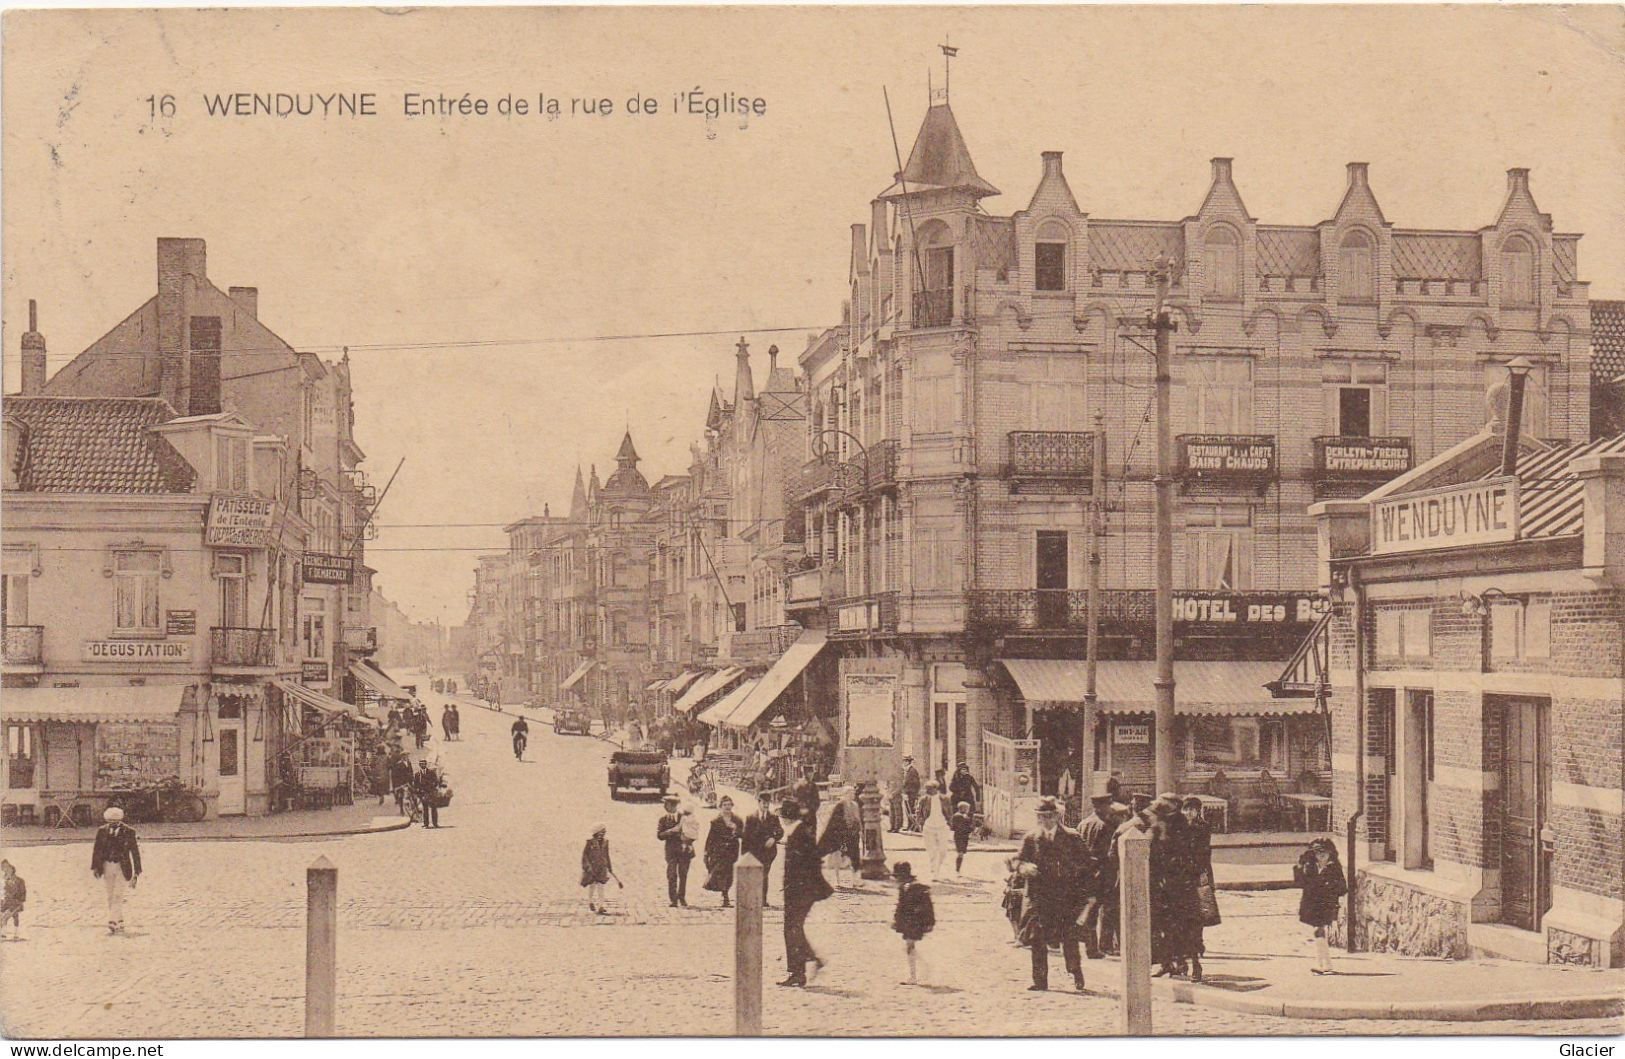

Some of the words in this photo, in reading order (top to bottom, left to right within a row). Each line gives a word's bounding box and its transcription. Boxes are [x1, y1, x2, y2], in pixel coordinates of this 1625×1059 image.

[1187, 445, 1232, 457] RESTAURANT
[1249, 446, 1272, 458] CARTE
[1189, 456, 1222, 469] BAINS
[1226, 456, 1268, 470] CHAUDS
[1326, 458, 1408, 471] ENTREPRENEURS
[217, 514, 227, 524] de
[1381, 489, 1508, 543] WENDUYNE
[1247, 605, 1287, 622] DES
